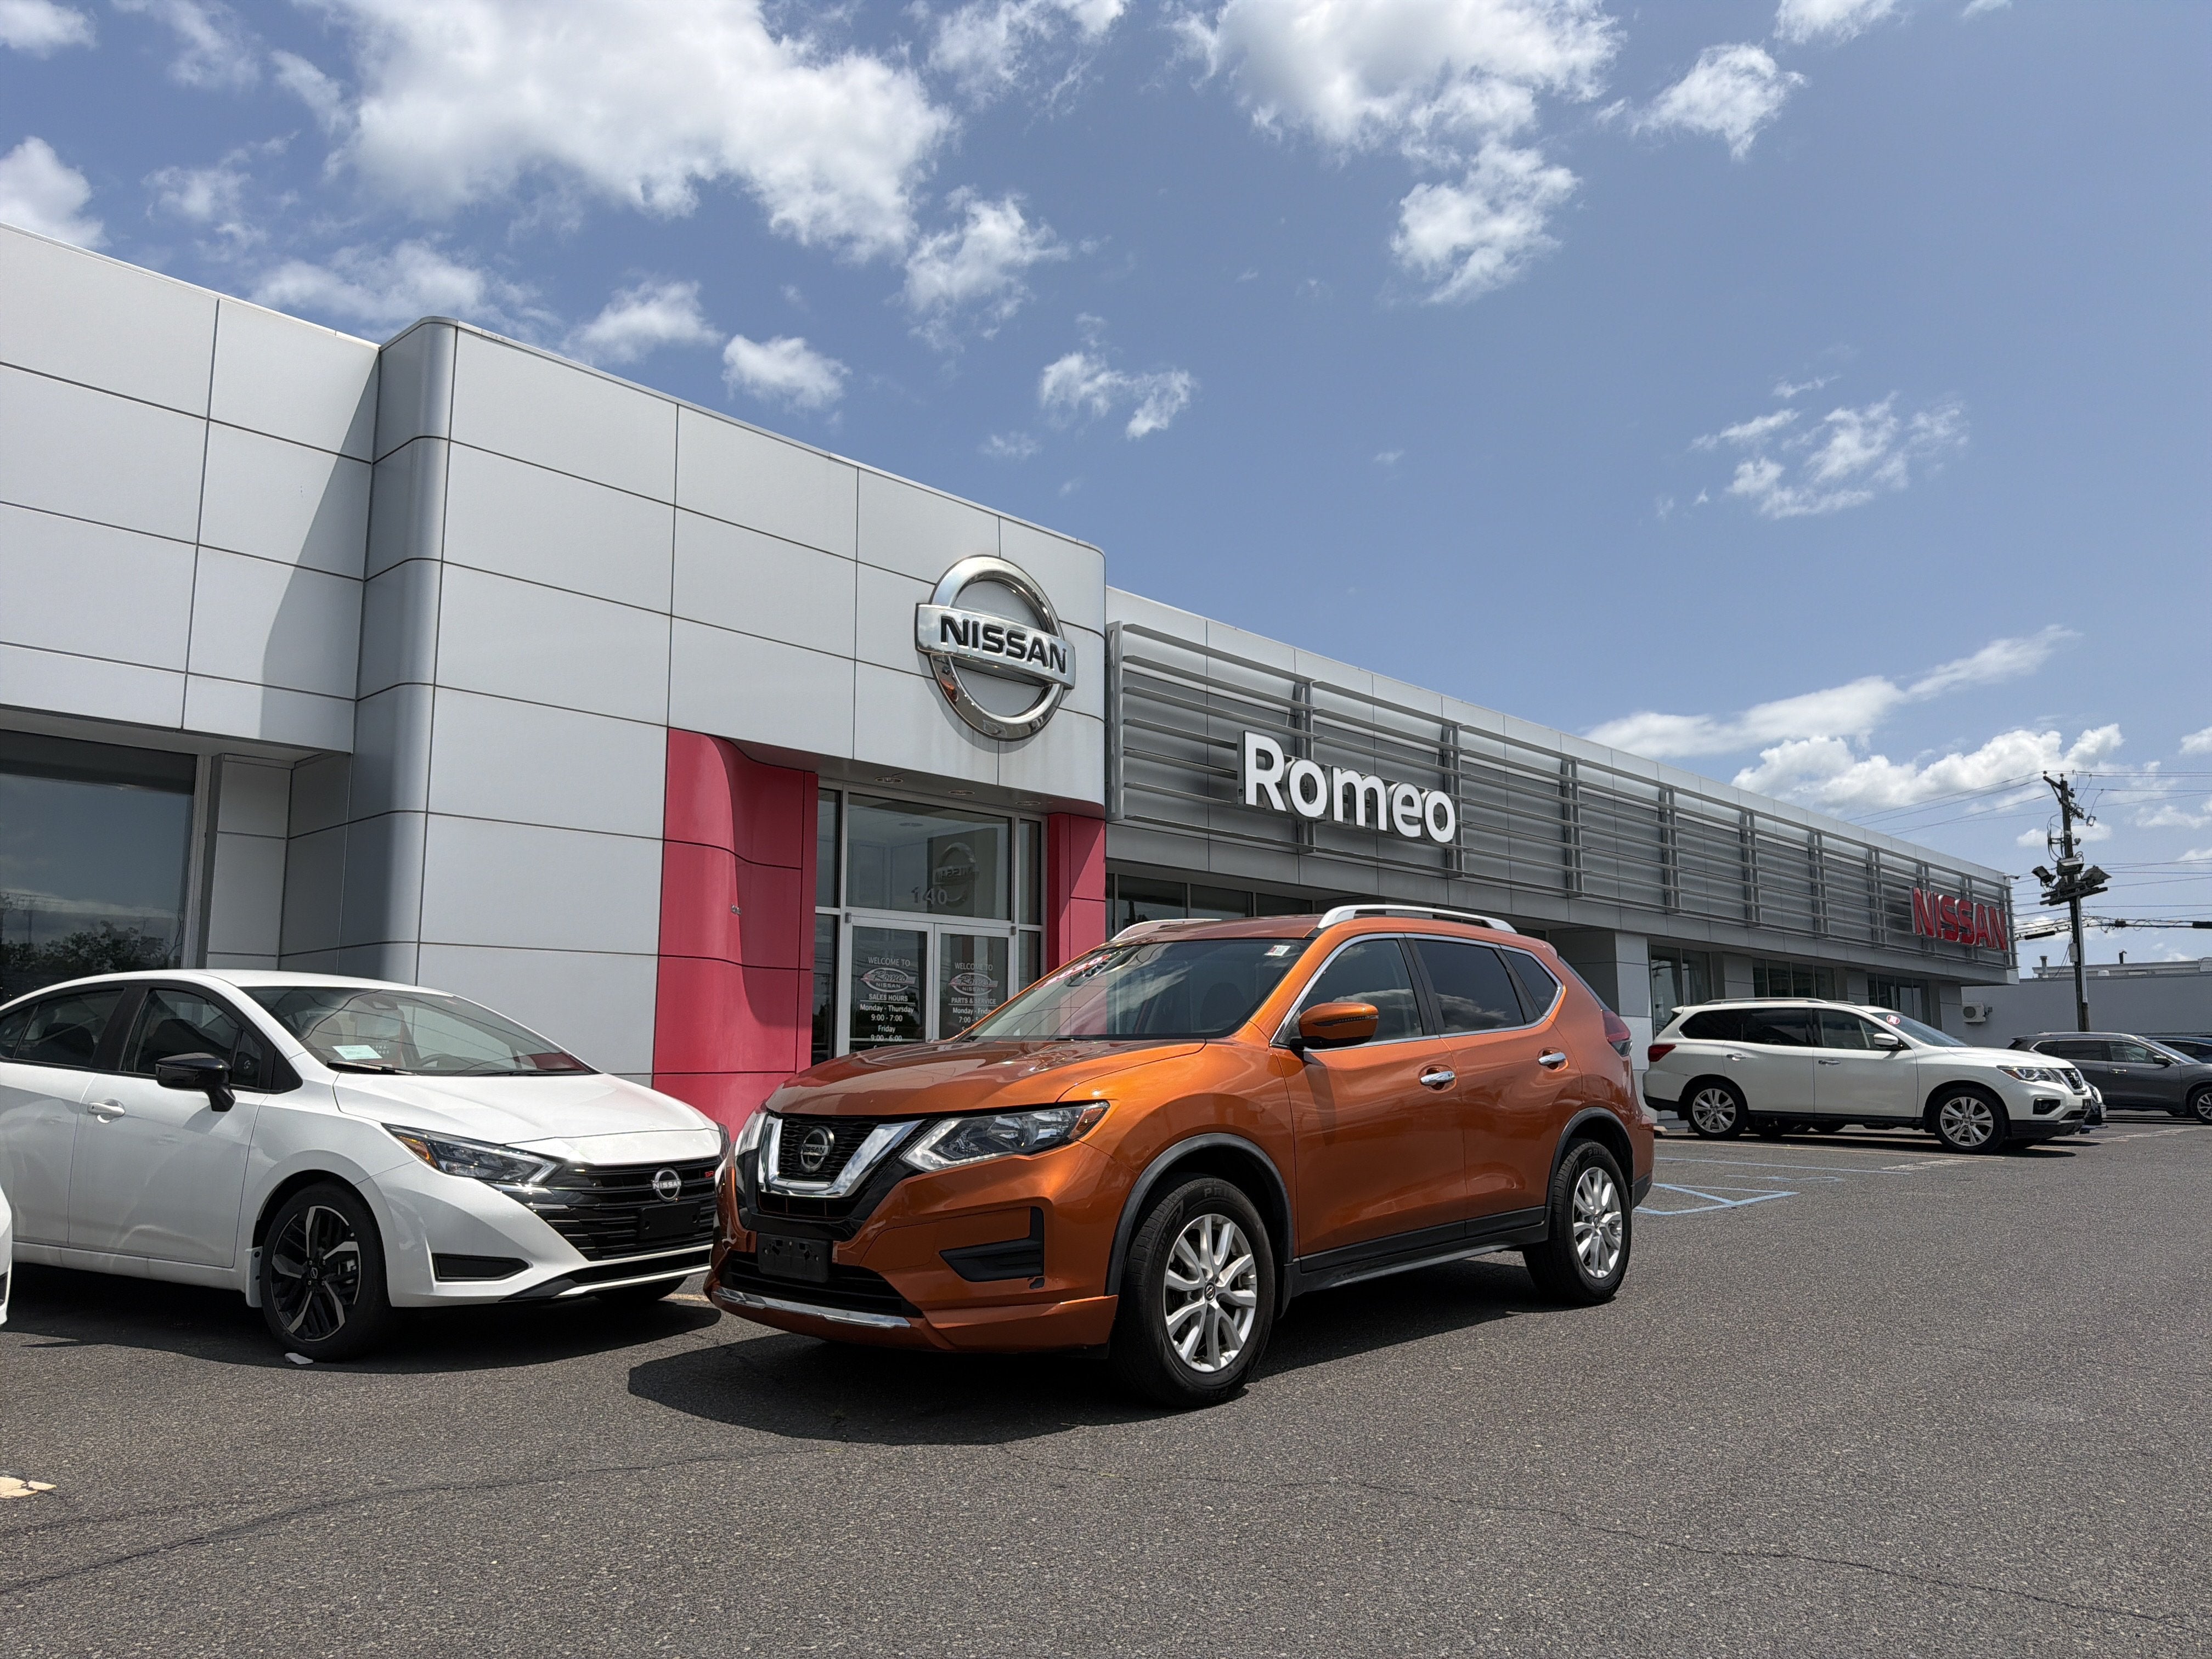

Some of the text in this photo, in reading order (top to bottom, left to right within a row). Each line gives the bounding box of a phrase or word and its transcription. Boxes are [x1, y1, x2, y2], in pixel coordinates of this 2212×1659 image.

[940, 615, 1066, 675] NISSAN
[1243, 730, 1456, 843] Romeo
[911, 886, 947, 905] 140
[1912, 887, 2007, 952] NISSAN
[868, 956, 900, 966] WELCOME
[955, 962, 984, 970] WELCOME
[873, 969, 907, 982] Romeo
[860, 1003, 883, 1012] Monday
[888, 1005, 914, 1014] Thursday
[878, 1025, 896, 1033] Friday
[652, 1181, 681, 1189] NISSAN
